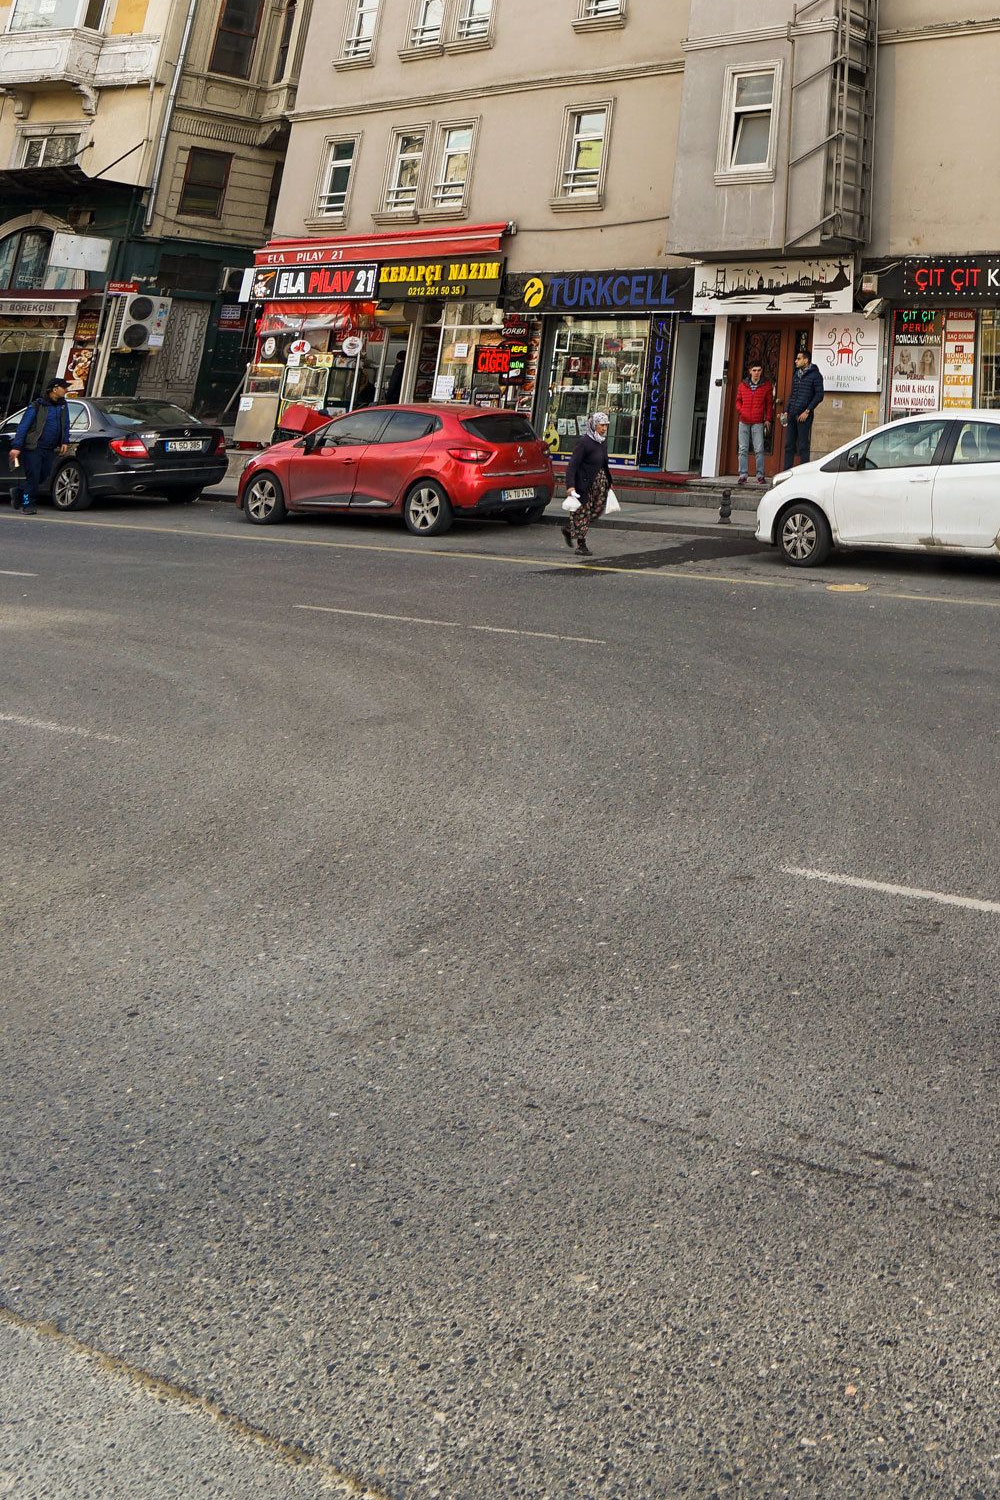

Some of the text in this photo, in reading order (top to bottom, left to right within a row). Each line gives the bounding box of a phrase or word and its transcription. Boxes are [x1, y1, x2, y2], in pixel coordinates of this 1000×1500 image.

[267, 250, 344, 263] ELA PILAV 21
[278, 267, 374, 294] ELA PİLAV 21
[379, 262, 500, 286] KEBAPÇI NAZIM
[914, 268, 945, 291] ÇIT
[951, 268, 981, 291] ÇIT
[408, 285, 460, 296] 0212 251 50 35
[551, 275, 675, 307] TURKCELL
[903, 310, 936, 320] ÇIT ÇIT
[948, 311, 973, 319] PERUK
[902, 323, 935, 332] PERUK
[647, 322, 665, 455] TURKCELL
